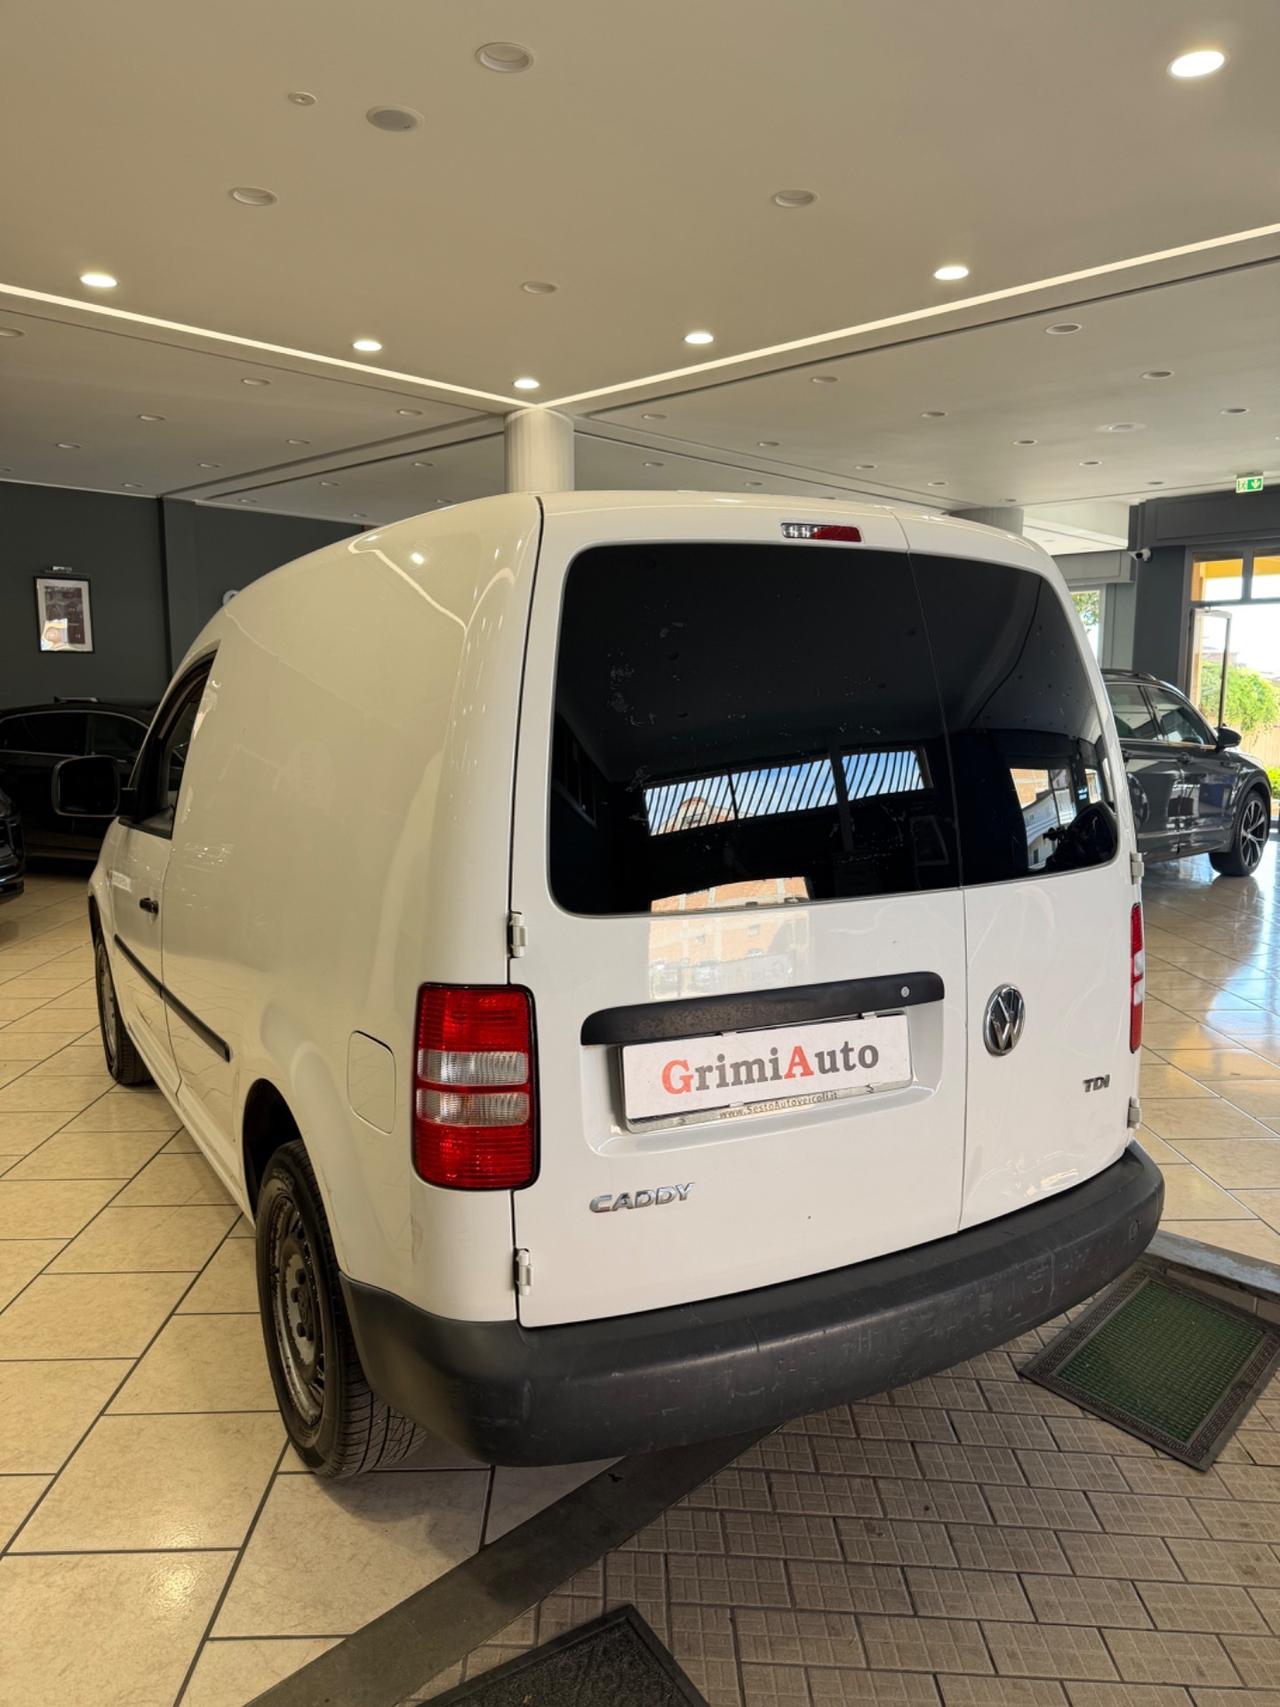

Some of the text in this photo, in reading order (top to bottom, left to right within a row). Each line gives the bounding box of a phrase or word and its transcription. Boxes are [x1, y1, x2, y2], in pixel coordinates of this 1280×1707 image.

[662, 1040, 880, 1095] GrimiAuto
[1083, 1074, 1110, 1093] TDI
[589, 1182, 695, 1213] CADDY
